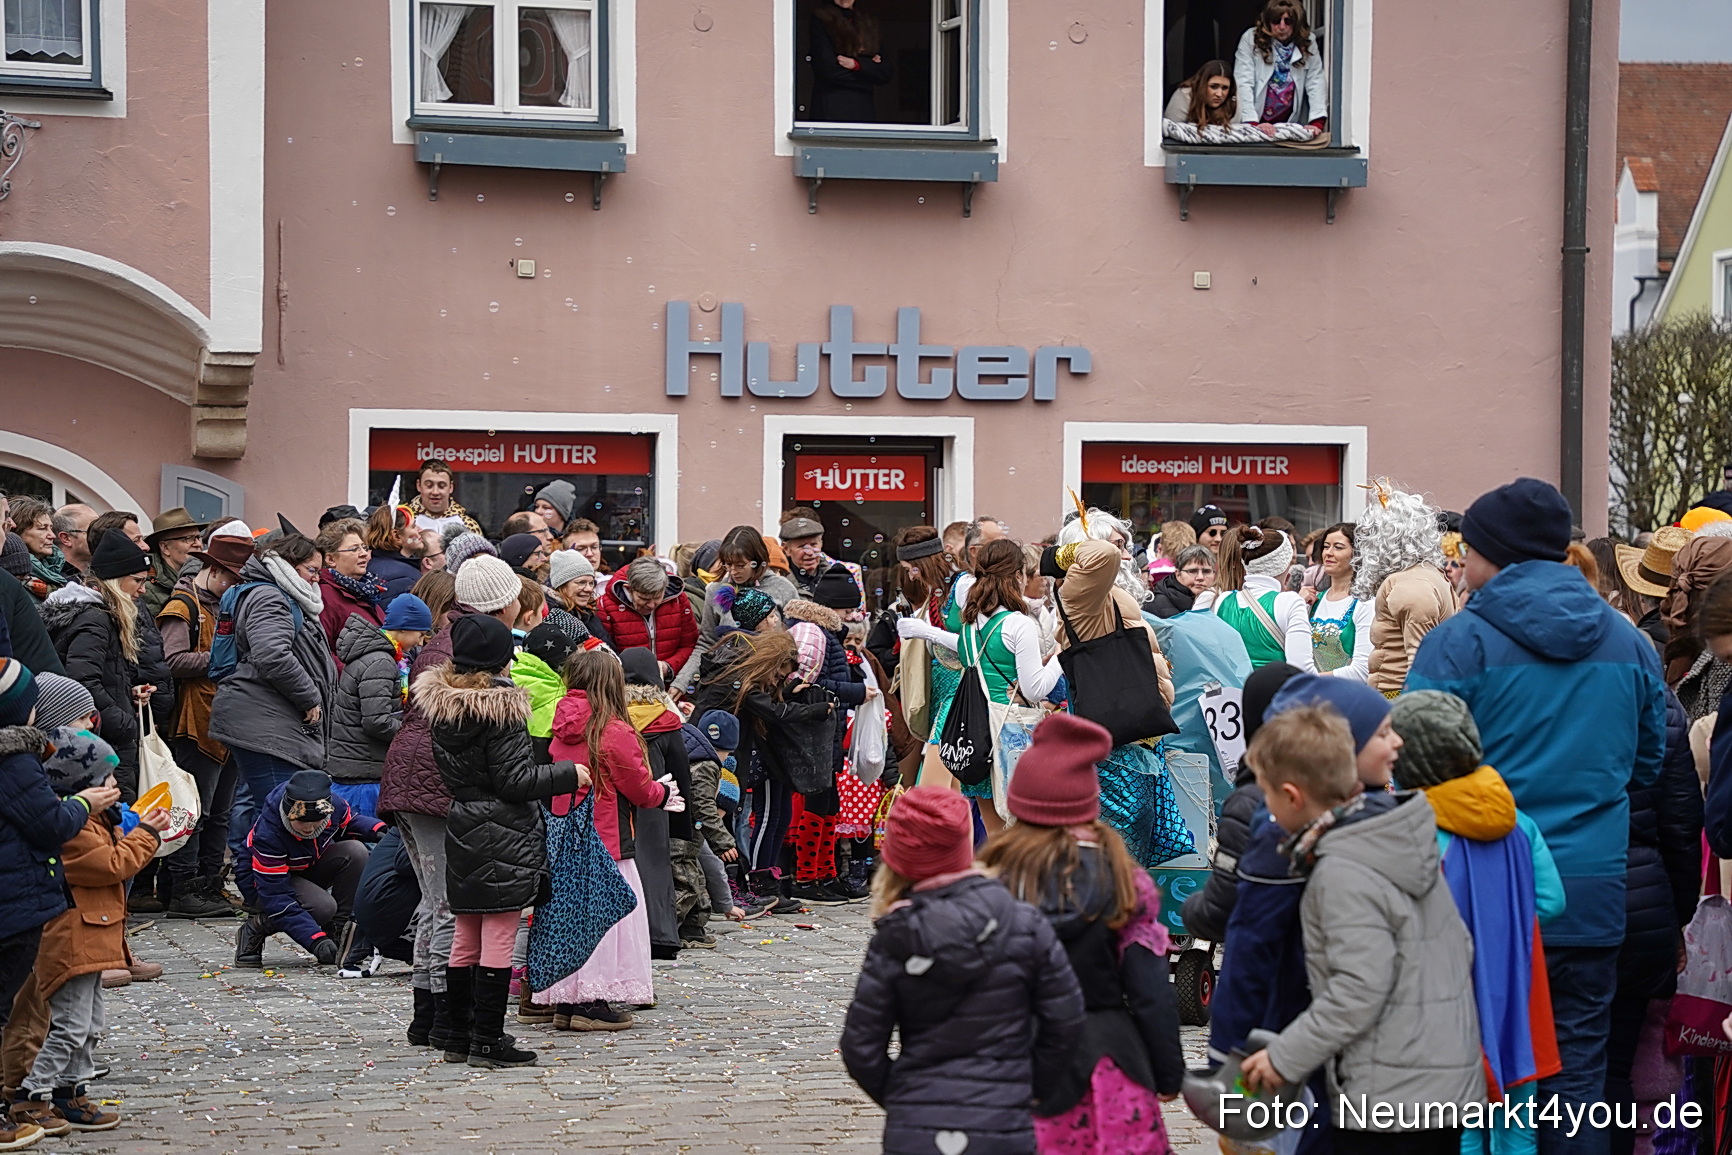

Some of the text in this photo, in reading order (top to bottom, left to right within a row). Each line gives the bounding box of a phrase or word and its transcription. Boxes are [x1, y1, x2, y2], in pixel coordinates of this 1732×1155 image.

[666, 301, 1091, 400] Hutter
[416, 442, 597, 465] idee+spiel HUTTER
[1121, 454, 1289, 477] idee+spiel HUTTER
[815, 468, 905, 490] HUTTER
